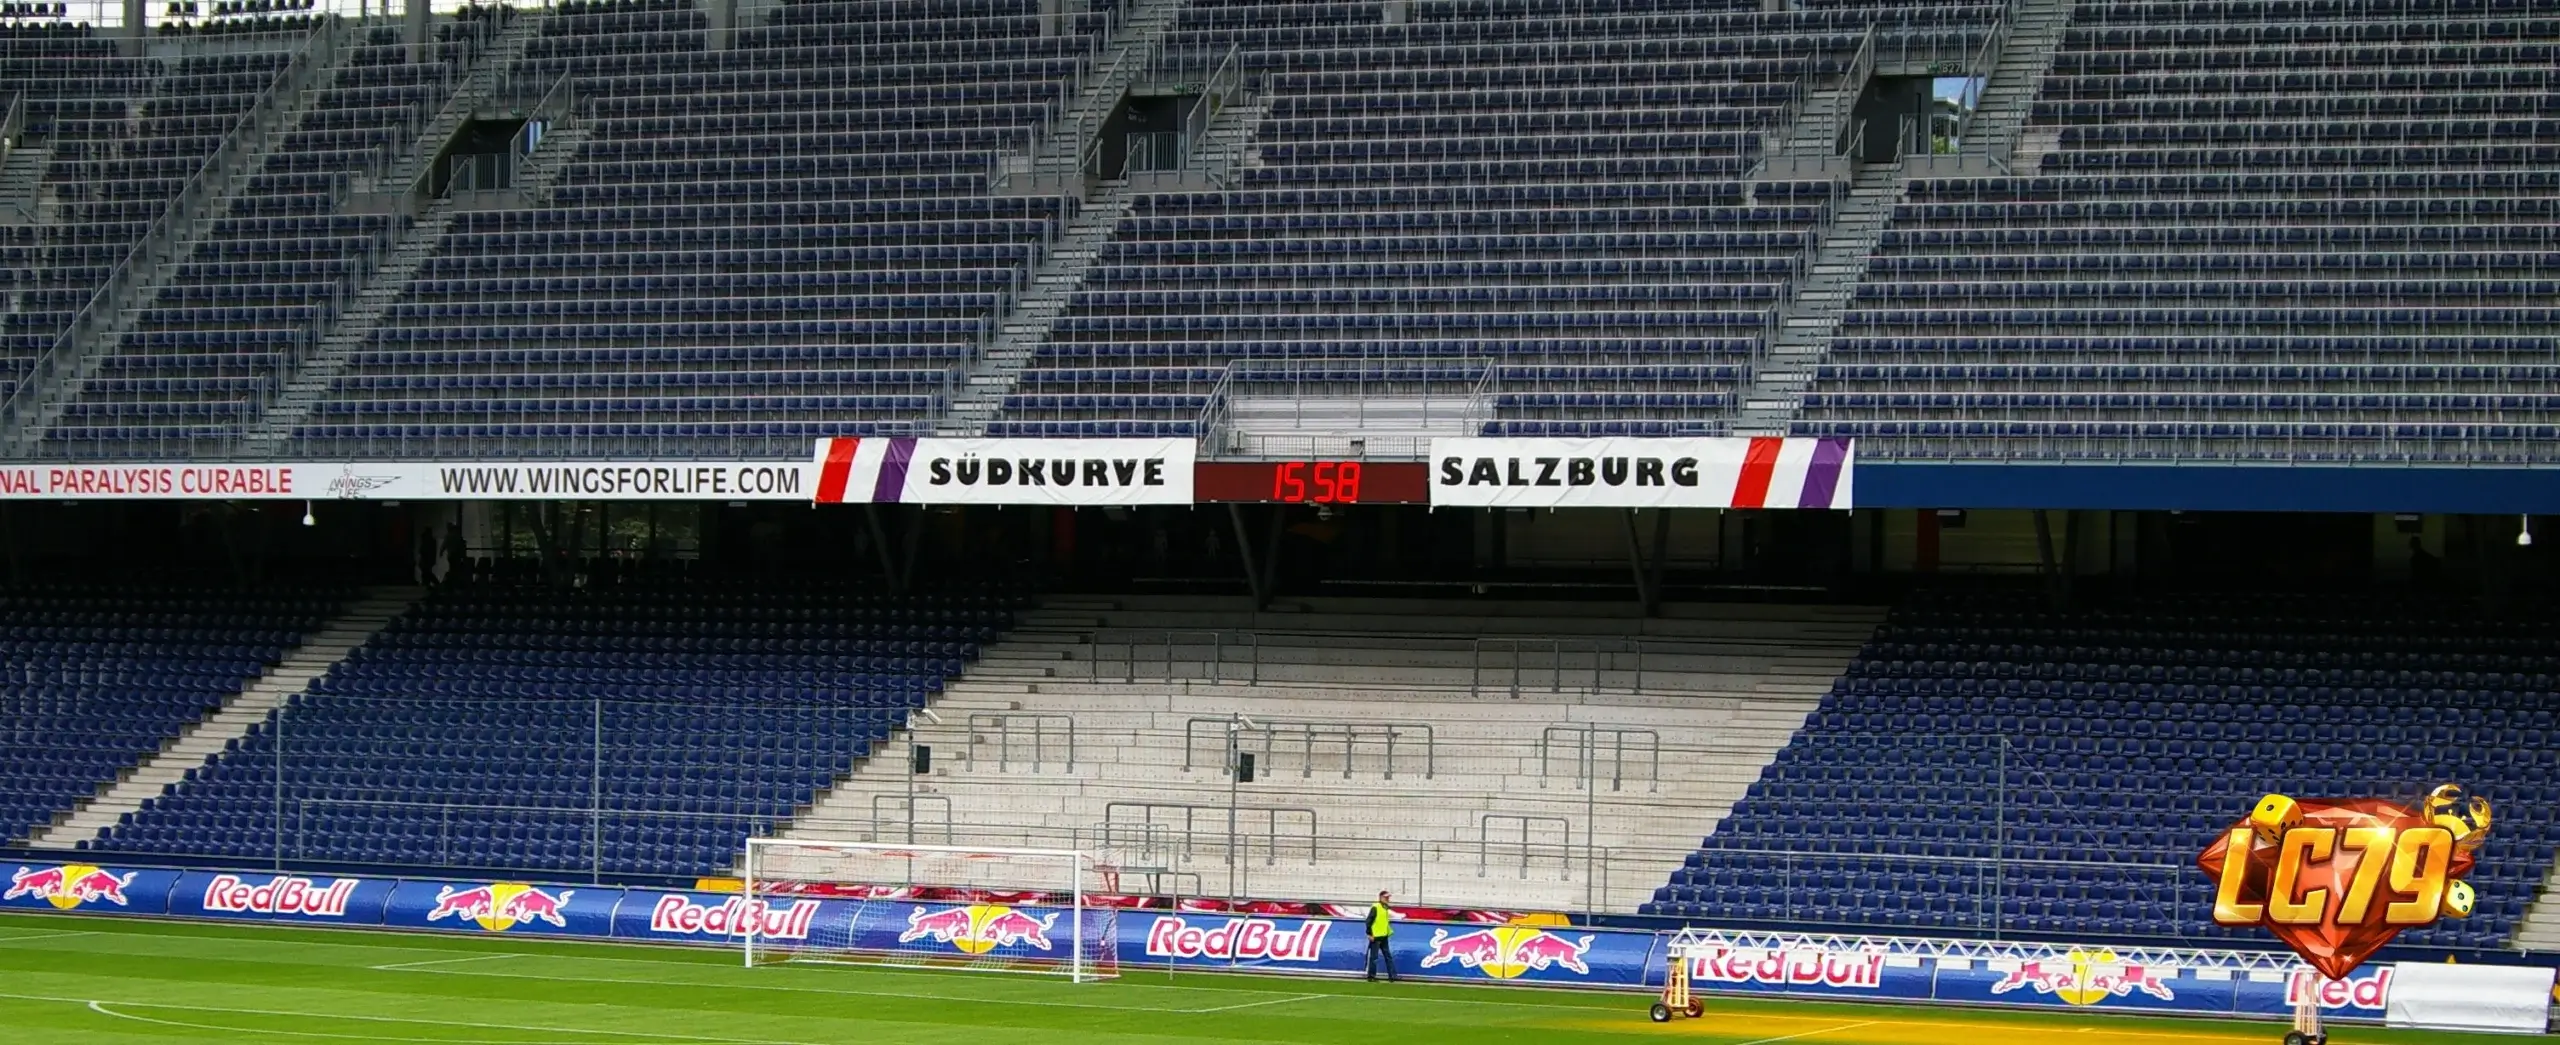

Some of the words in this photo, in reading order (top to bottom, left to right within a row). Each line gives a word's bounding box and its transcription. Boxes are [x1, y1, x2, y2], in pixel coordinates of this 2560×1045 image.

[50, 469, 172, 494] PARALYSIS
[181, 468, 292, 494] CURABLE
[440, 467, 800, 494] WWW.WINGSFORLIFE.COM
[929, 452, 1165, 487] SÜDKURVE
[1440, 456, 1700, 487] SALZBURG
[206, 876, 285, 912] Red
[277, 878, 356, 914] Bull
[652, 897, 735, 932] Red
[734, 901, 818, 937] Bull
[1148, 917, 1240, 957] Red
[1238, 921, 1331, 960] Bull
